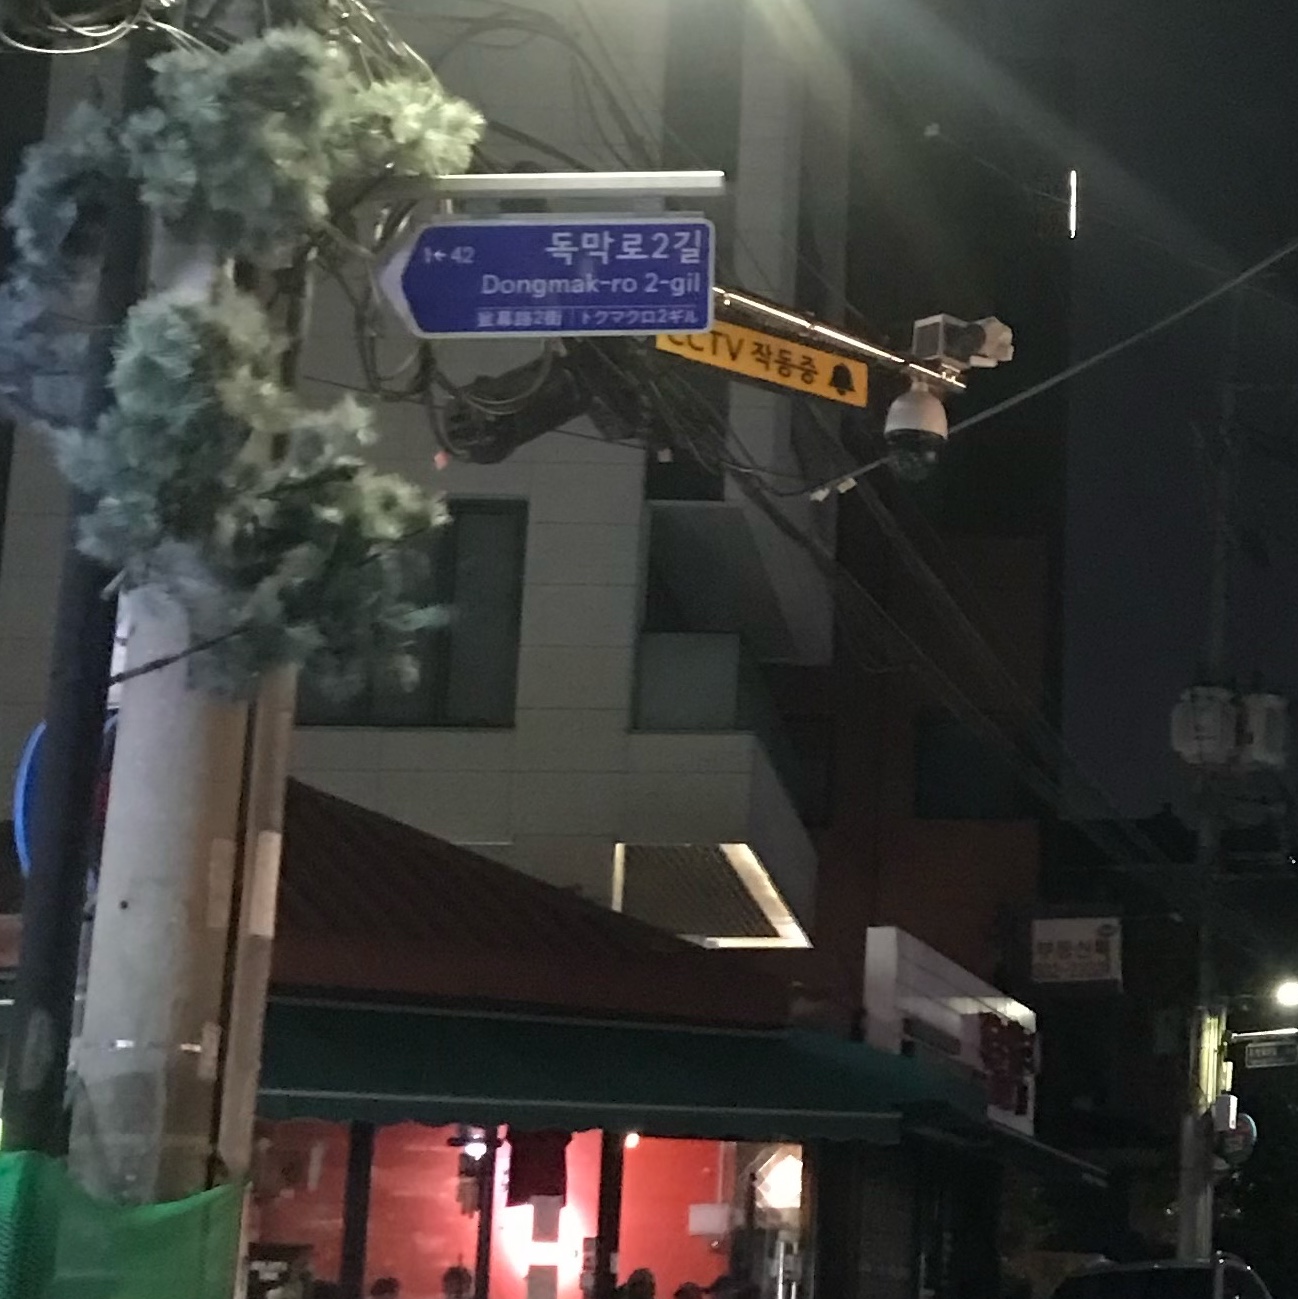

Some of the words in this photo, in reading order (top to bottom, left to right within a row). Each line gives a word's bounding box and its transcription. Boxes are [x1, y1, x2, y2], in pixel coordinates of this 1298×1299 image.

[450, 246, 475, 264] 42
[546, 230, 701, 266] 독막로2길
[481, 273, 637, 298] Dongmak-ro
[644, 272, 700, 297] 2-gil
[751, 340, 819, 385] 작동중
